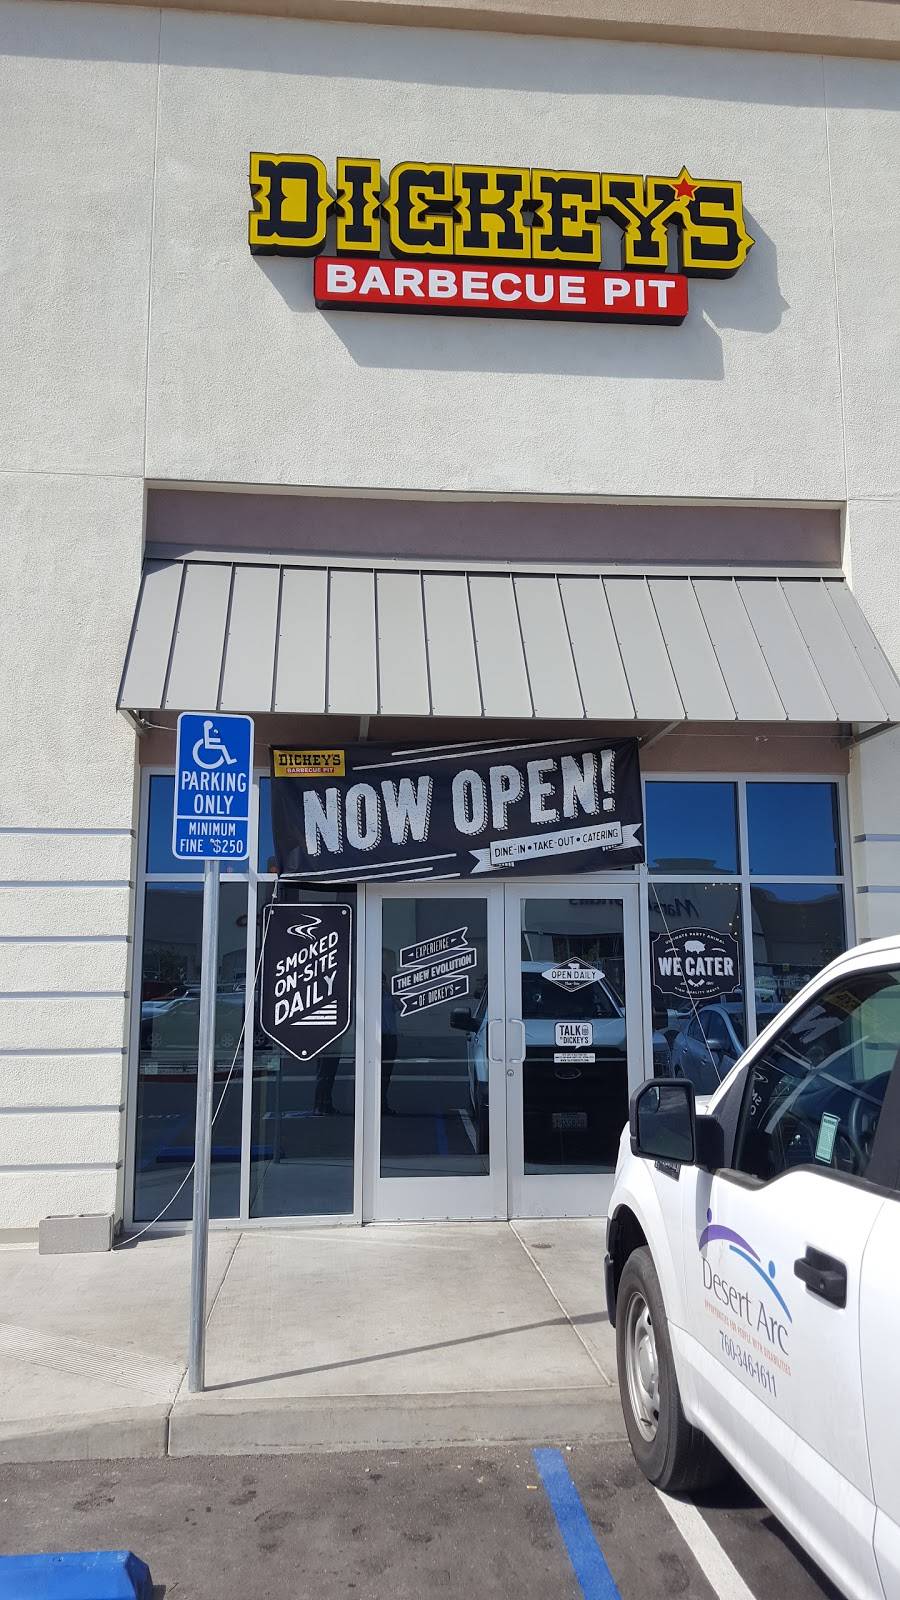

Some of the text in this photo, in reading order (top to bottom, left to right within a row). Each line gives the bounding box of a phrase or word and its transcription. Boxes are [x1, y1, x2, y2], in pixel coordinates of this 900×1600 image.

[326, 264, 675, 308] BARBECUE PIT
[279, 753, 341, 766] DICKEY'S
[181, 770, 247, 793] PARKING
[193, 793, 234, 815] ONLY
[303, 750, 616, 857] NOW OPEN!
[188, 821, 236, 837] MINIMUM
[179, 838, 244, 854] FINE $250
[494, 828, 619, 858] DINE-IN TAKE-OUT CATERING
[276, 931, 339, 977] SMOKED
[415, 937, 450, 959] EXPERIENCE
[274, 949, 338, 998] ON-SITE
[397, 954, 472, 989] THE NEW EVOLUTION
[551, 970, 596, 979] OPEN DAILY
[658, 957, 735, 977] WE CATER
[274, 970, 337, 1026] DAILY
[418, 993, 426, 1007] OF
[559, 1025, 581, 1036] TALK
[702, 1255, 753, 1327] Desert
[756, 1300, 789, 1357] Arc
[719, 1330, 777, 1398] 760-346-1611
